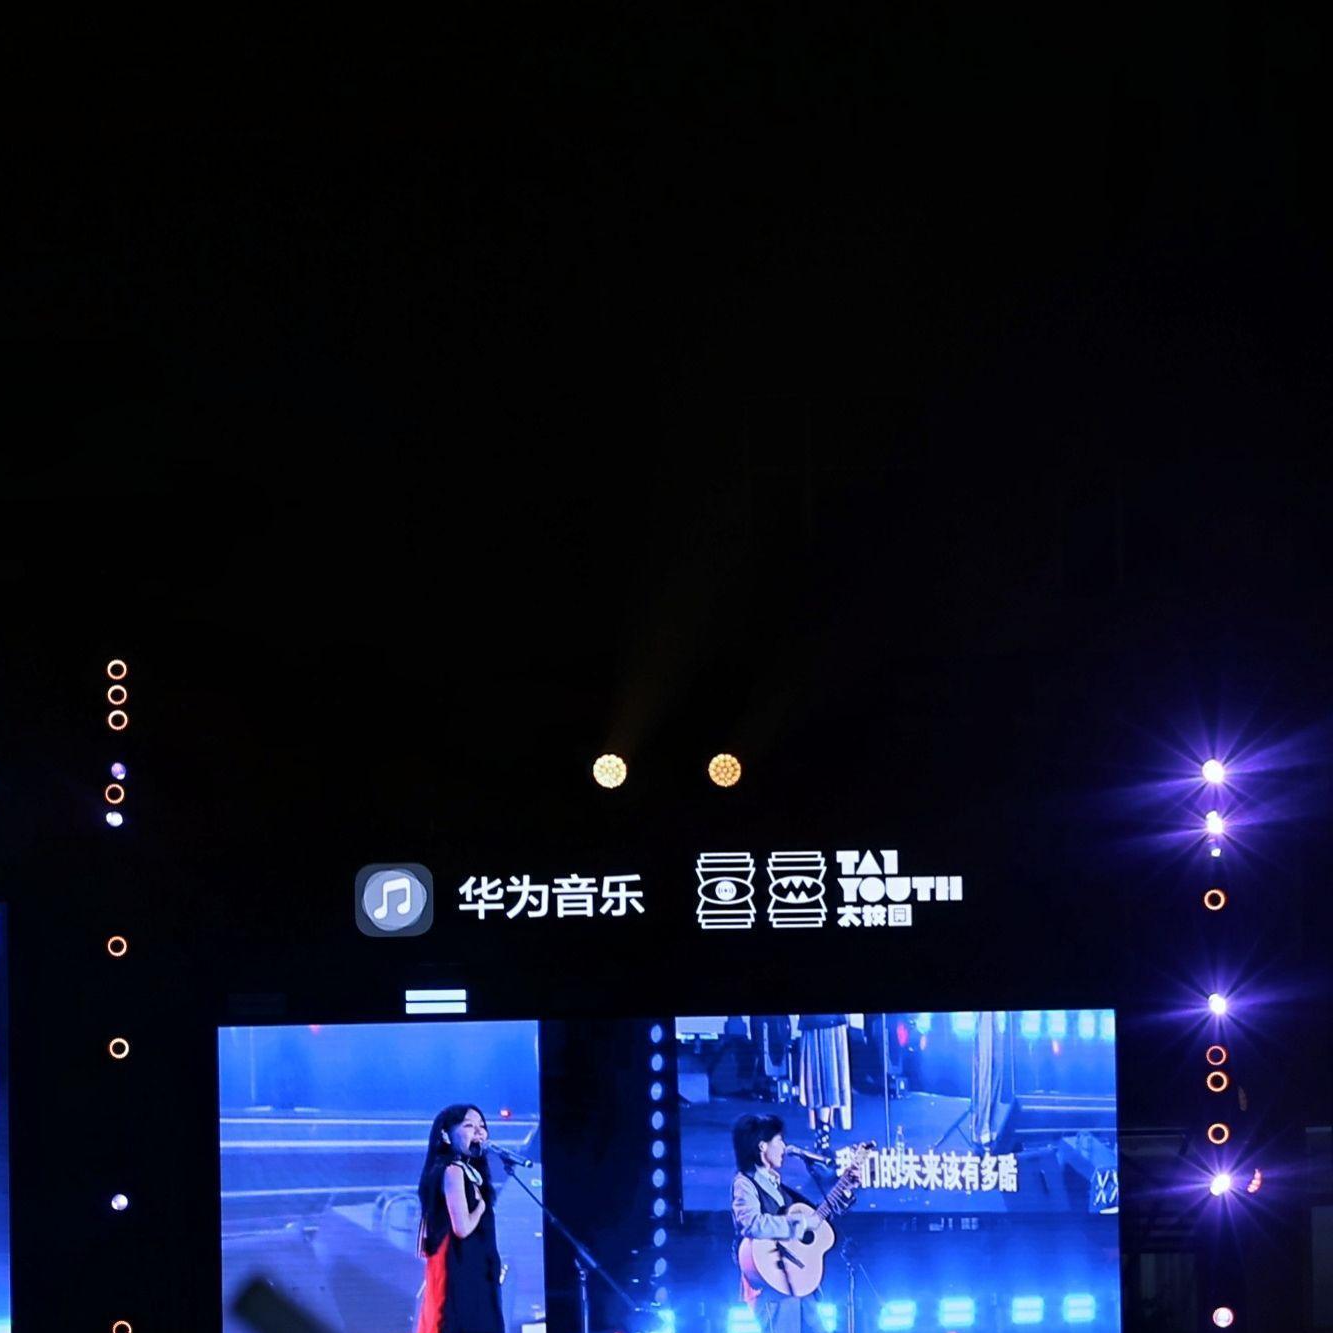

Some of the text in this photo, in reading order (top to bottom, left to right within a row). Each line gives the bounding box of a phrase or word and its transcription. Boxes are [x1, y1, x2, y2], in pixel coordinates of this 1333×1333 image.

[836, 849, 899, 876] TAI
[458, 873, 645, 920] 华为音乐
[837, 876, 963, 903] YOUTH
